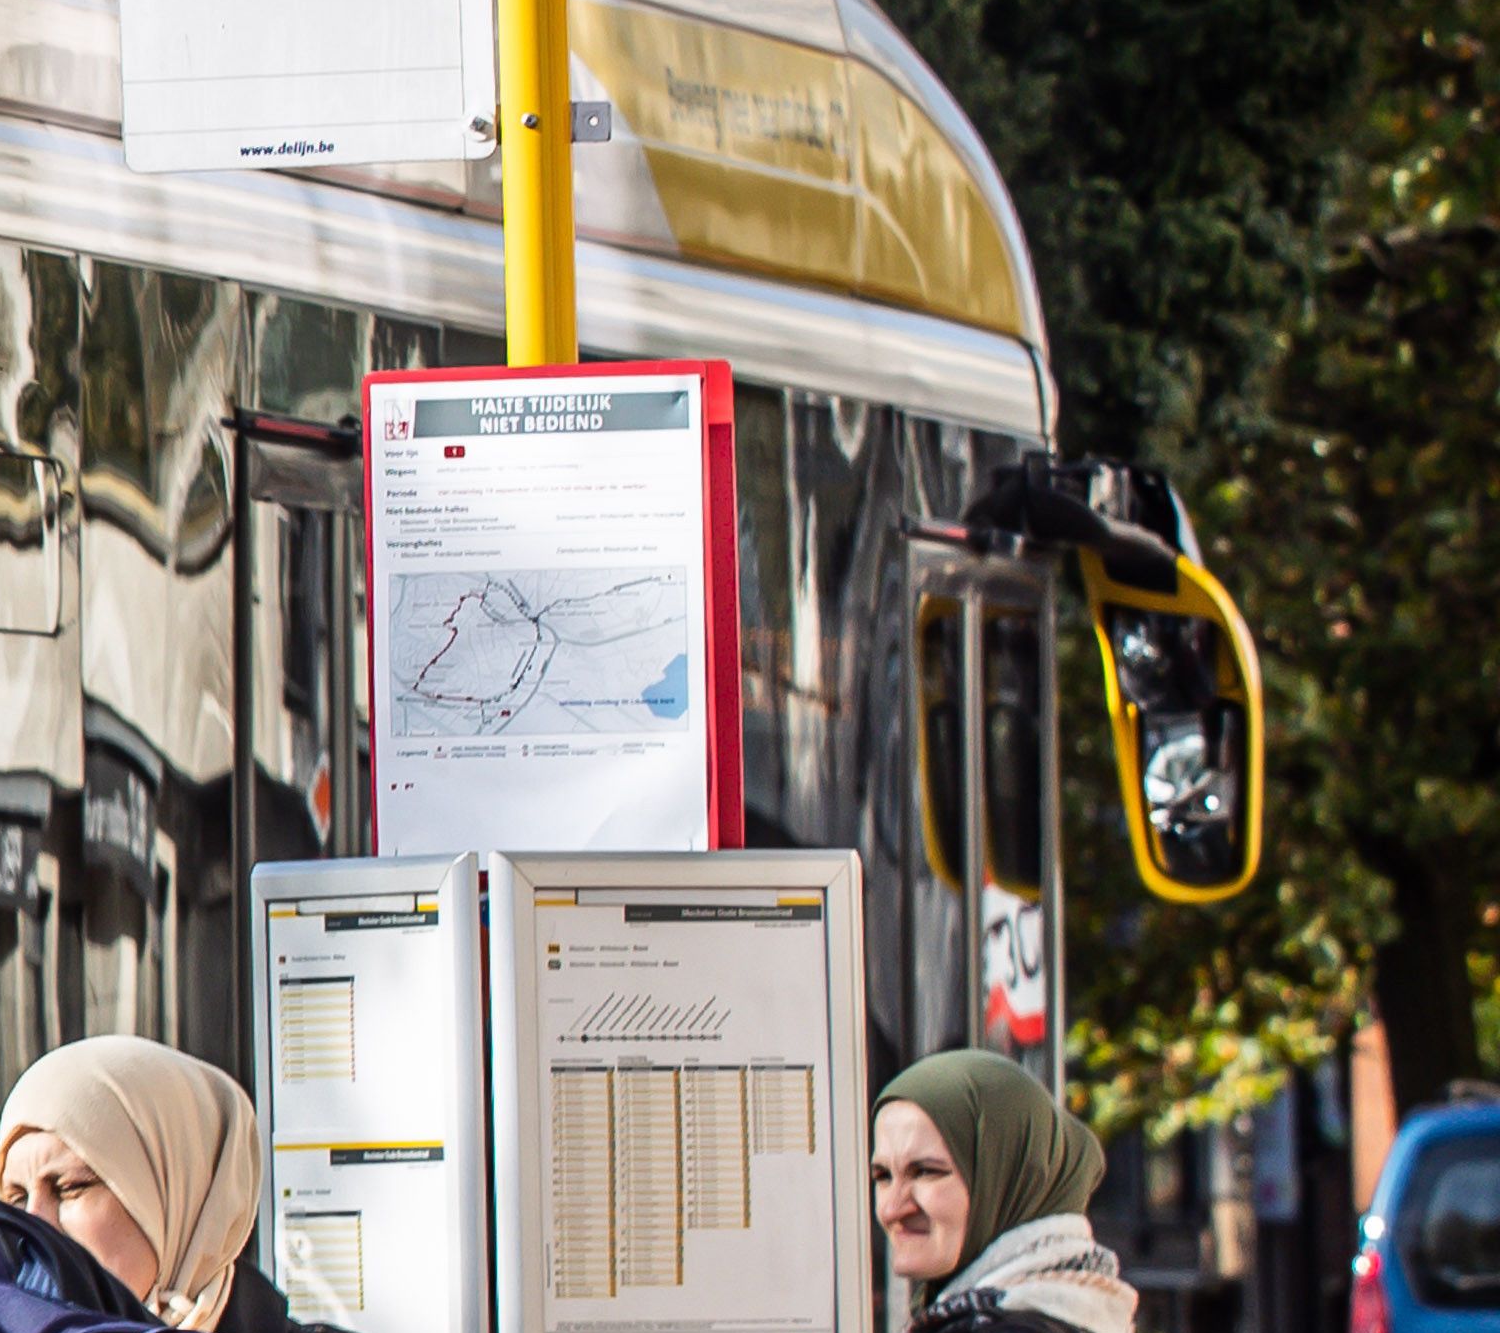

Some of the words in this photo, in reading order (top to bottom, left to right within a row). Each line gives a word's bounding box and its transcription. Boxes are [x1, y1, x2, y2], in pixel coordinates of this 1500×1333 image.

[240, 140, 335, 156] www.delijn.be
[471, 397, 524, 415] HALTE
[528, 394, 612, 413] TIJDELIJK
[480, 416, 520, 434] NIET
[524, 414, 603, 433] BEDIEND
